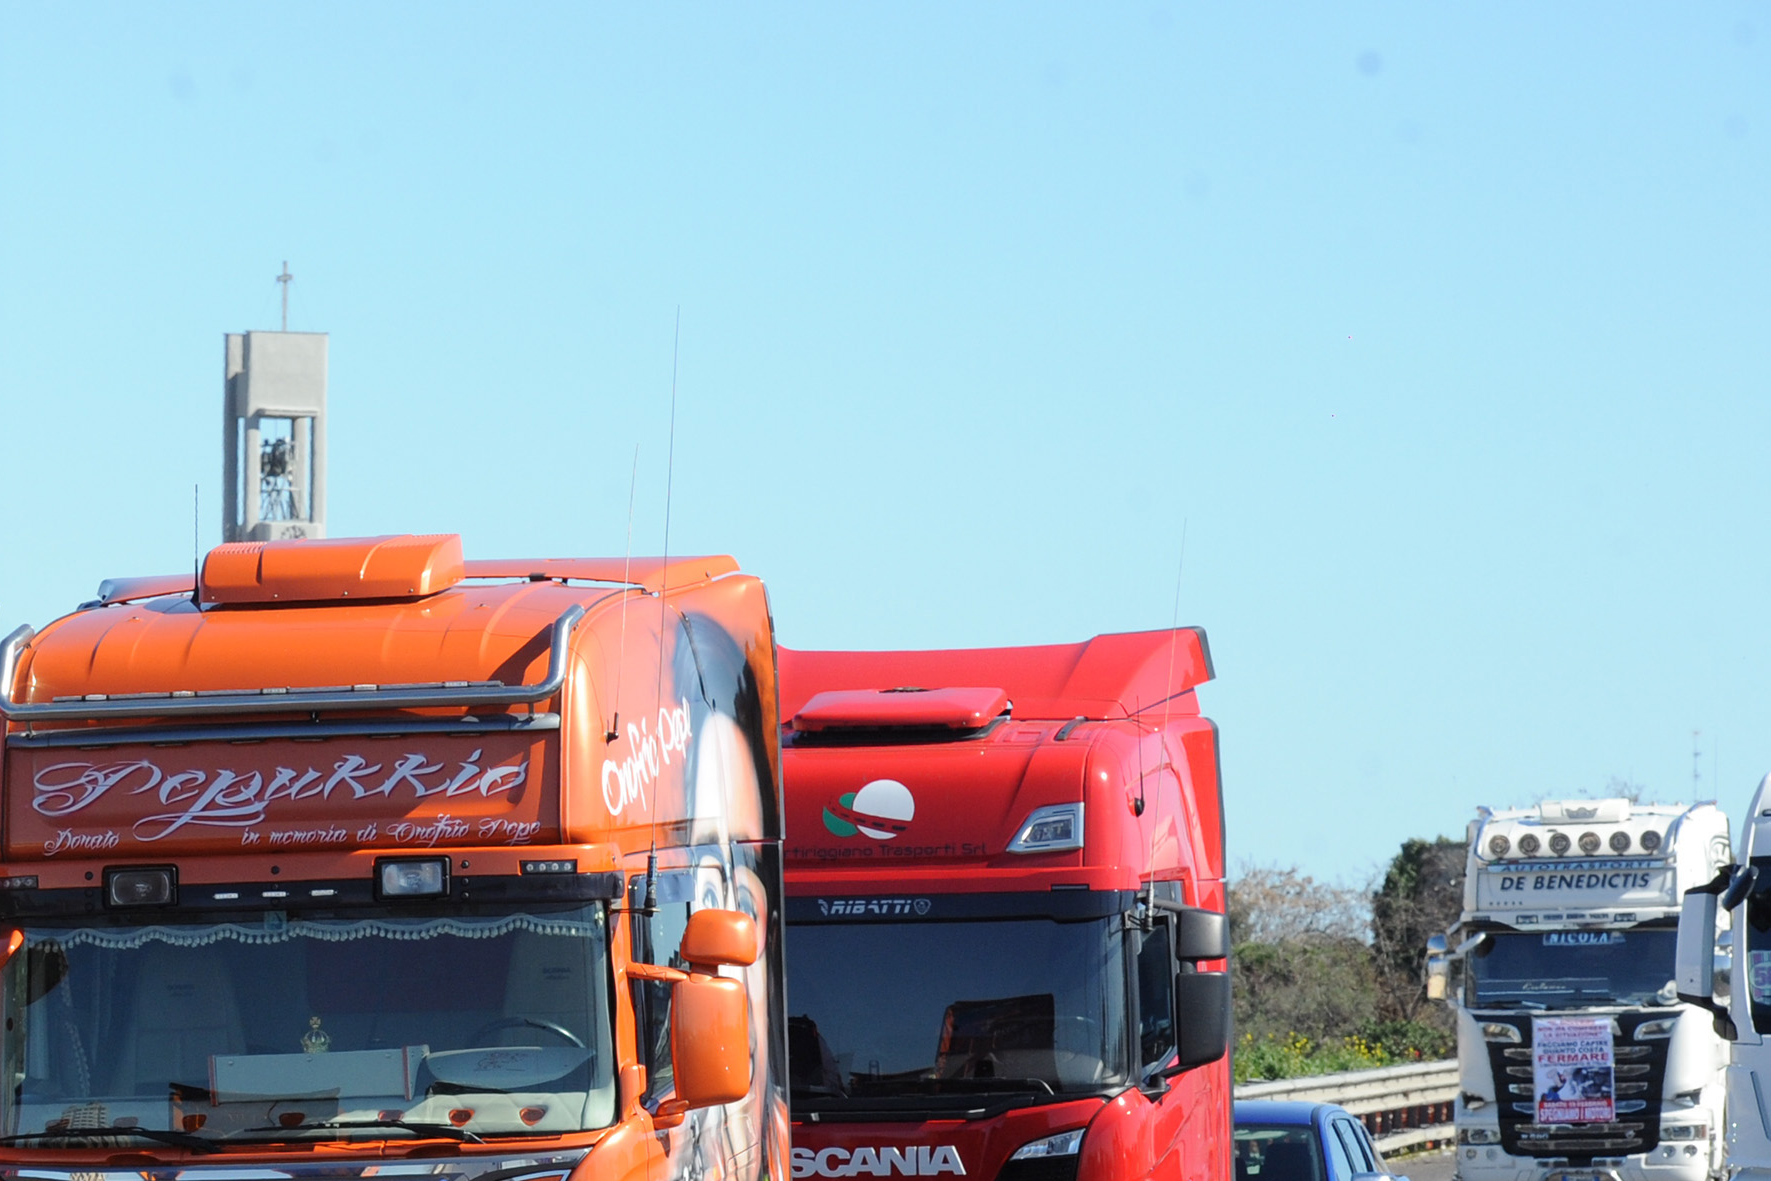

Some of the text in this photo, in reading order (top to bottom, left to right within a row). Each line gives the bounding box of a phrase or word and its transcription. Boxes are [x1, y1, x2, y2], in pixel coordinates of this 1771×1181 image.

[240, 826, 262, 846] in
[268, 826, 347, 846] memoria
[356, 821, 377, 842] di
[386, 813, 470, 850] Onofrio
[43, 827, 121, 857] Donato
[879, 843, 956, 858] Trasporti
[962, 842, 987, 855] Srl
[1500, 873, 1650, 891] DE BENEDICTIS
[1548, 932, 1609, 944] NICOLA
[1538, 1052, 1609, 1063] FERMARE
[792, 1145, 967, 1178] SCANIA
